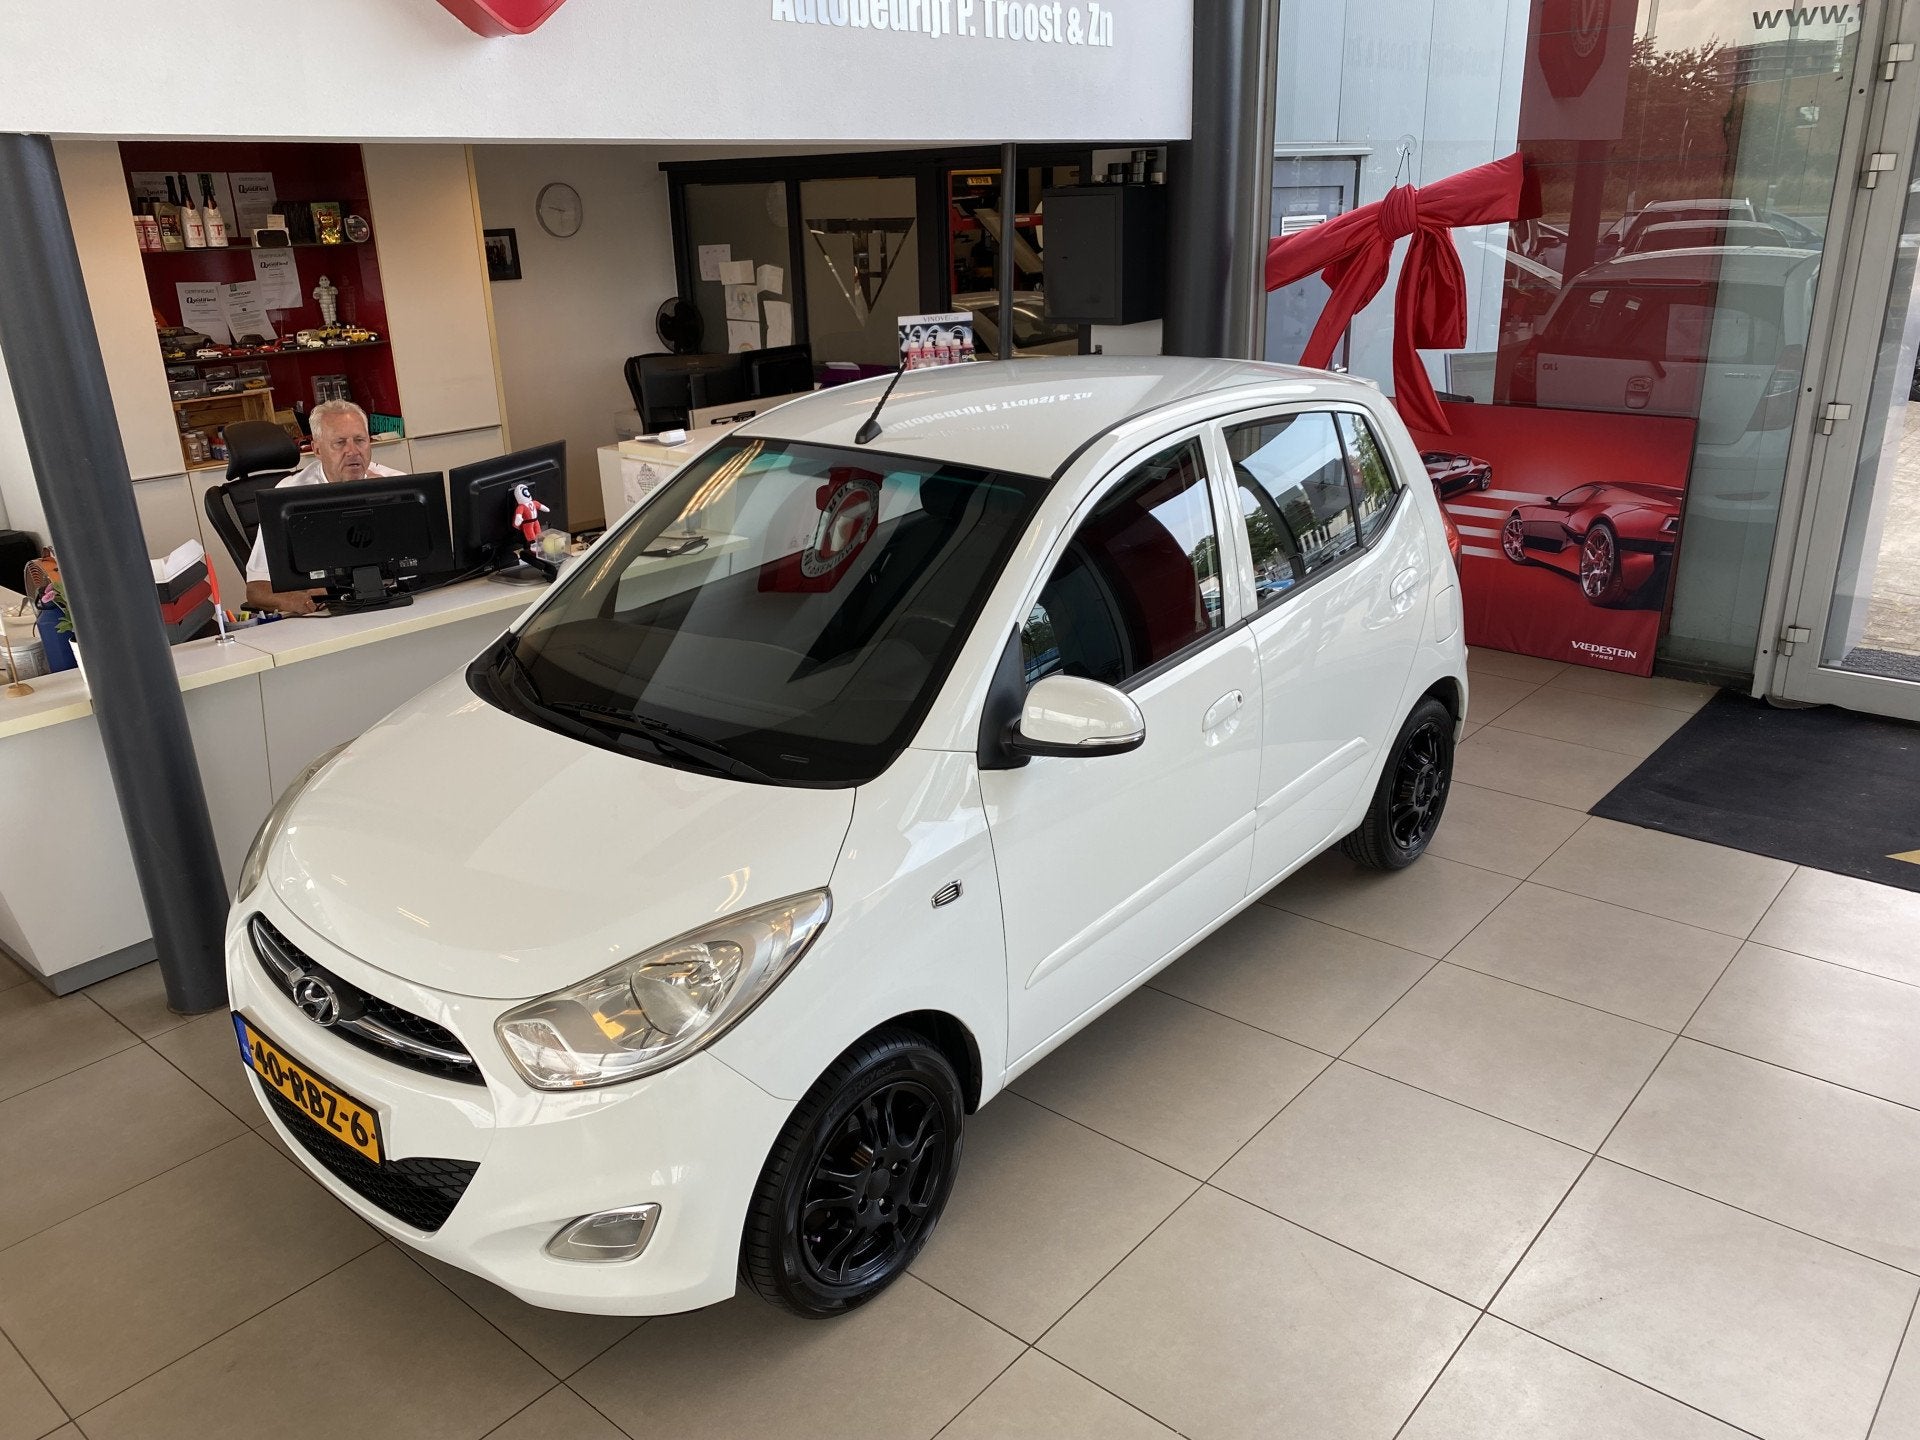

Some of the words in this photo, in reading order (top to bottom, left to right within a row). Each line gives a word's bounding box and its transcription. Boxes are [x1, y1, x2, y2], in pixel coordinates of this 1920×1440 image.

[983, 0, 1062, 43] Troost
[1067, 7, 1084, 45] &
[1087, 2, 1113, 47] Zn
[1571, 640, 1637, 659] VREDESTEIN
[1590, 653, 1613, 661] TYRES
[254, 1040, 368, 1147] 40-RBZ-6
